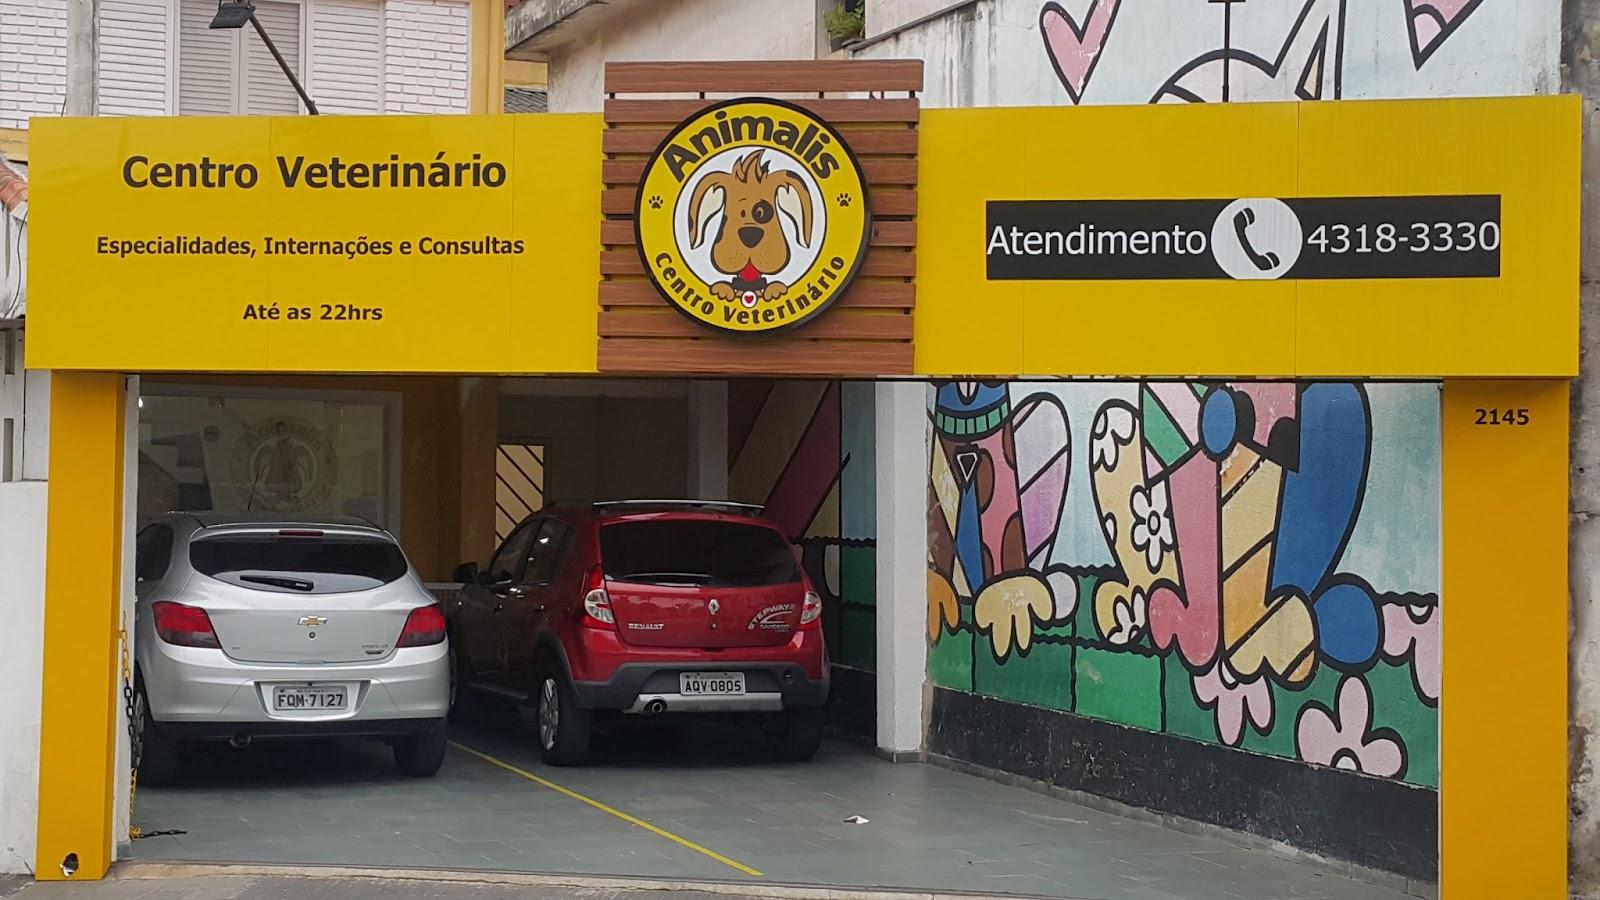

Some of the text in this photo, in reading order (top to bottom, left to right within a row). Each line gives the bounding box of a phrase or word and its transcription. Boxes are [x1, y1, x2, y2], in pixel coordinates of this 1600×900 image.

[662, 111, 839, 183] Animalis
[124, 152, 506, 189] Centro Veterinário
[97, 235, 525, 260] Especialidades, Internações e Consultas
[987, 221, 1500, 256] Atendimento 4318-3330
[655, 252, 845, 325] Centro Veterinário
[243, 302, 383, 321] Até as 22hrs
[1474, 408, 1530, 426] 2145
